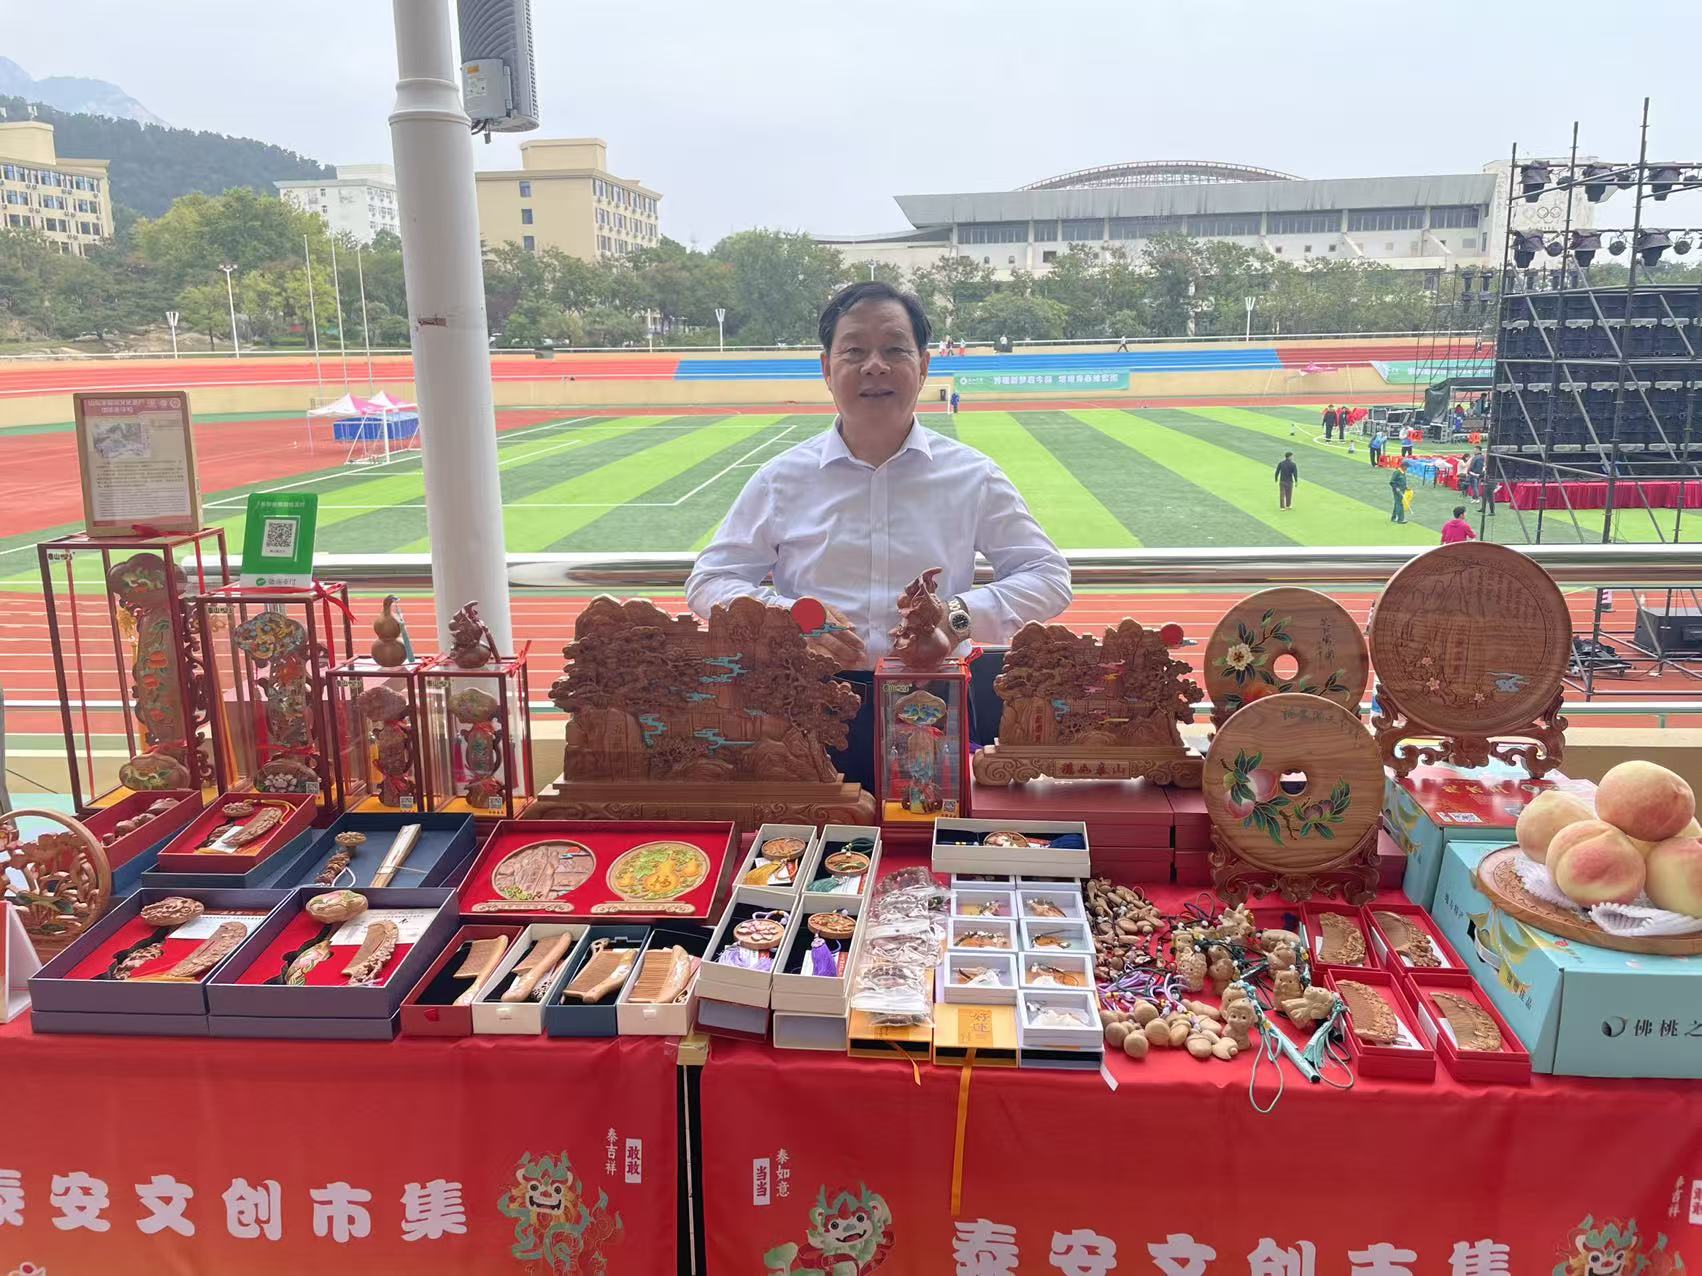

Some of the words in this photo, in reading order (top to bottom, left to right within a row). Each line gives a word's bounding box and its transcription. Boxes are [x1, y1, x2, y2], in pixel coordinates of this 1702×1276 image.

[1634, 1019, 1702, 1037] 佛桃之
[605, 1127, 618, 1176] 泰吉祥
[627, 1145, 640, 1176] 敢敢
[756, 1165, 767, 1197] 当当
[776, 1148, 790, 1197] 泰如意
